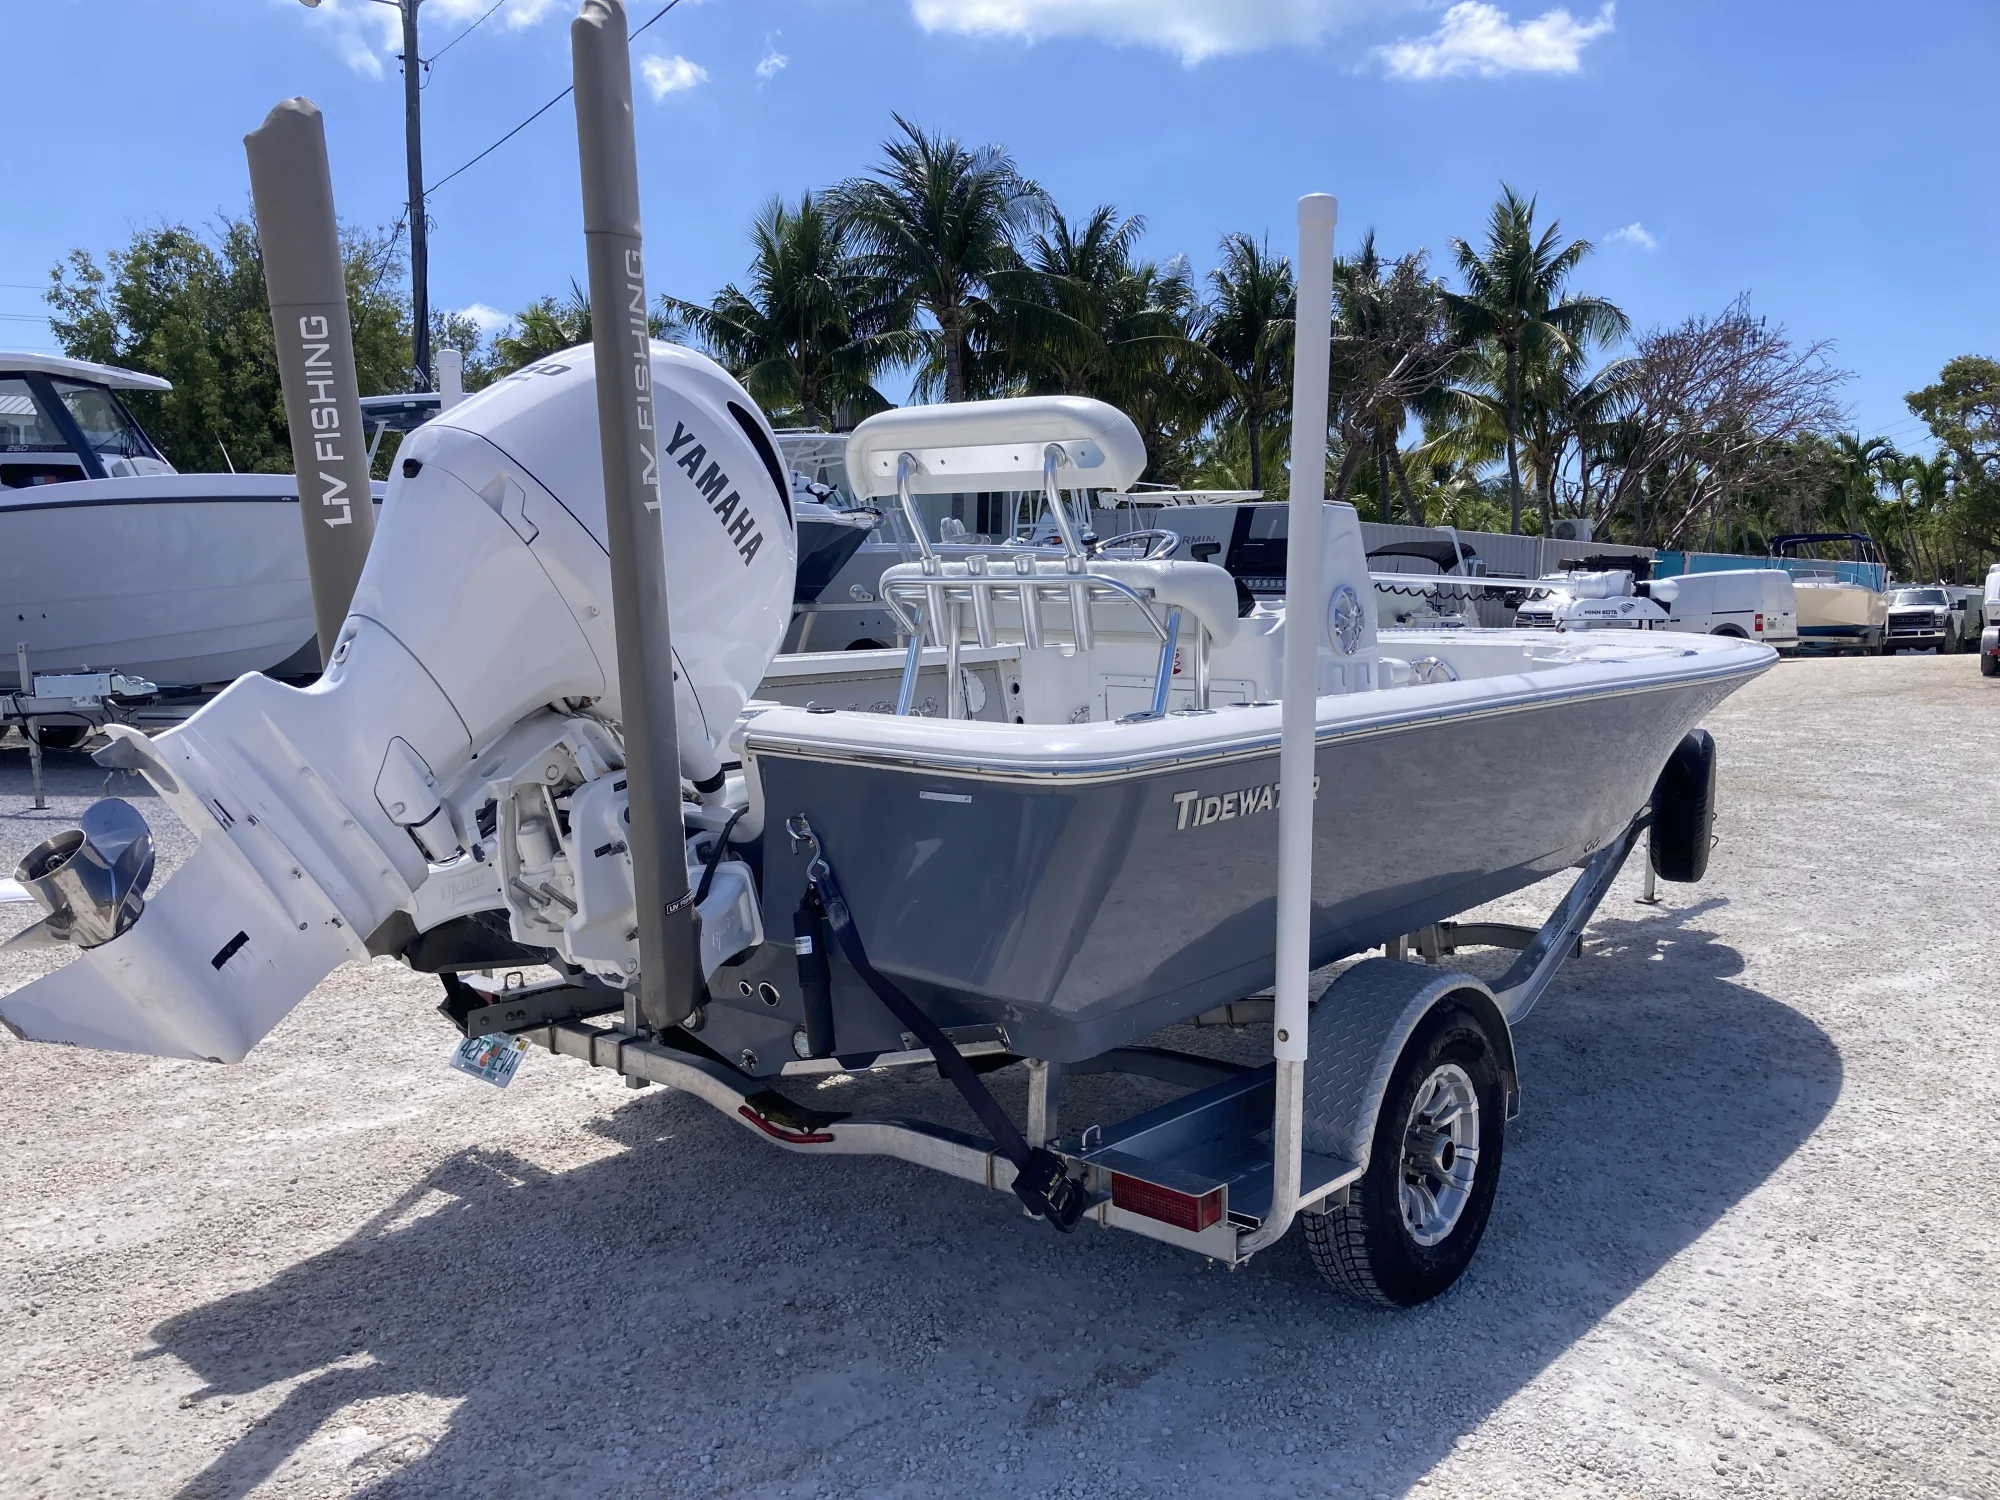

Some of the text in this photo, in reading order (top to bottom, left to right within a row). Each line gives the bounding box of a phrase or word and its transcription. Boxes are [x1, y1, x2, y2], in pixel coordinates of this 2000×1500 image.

[299, 315, 353, 528] LIV FISHING
[625, 249, 661, 514] LIV FISHING
[665, 421, 763, 567] YAMAHA
[1178, 535, 1216, 545] RMIN
[1172, 774, 1321, 831] TIDEWA
[460, 1038, 490, 1061] 42F
